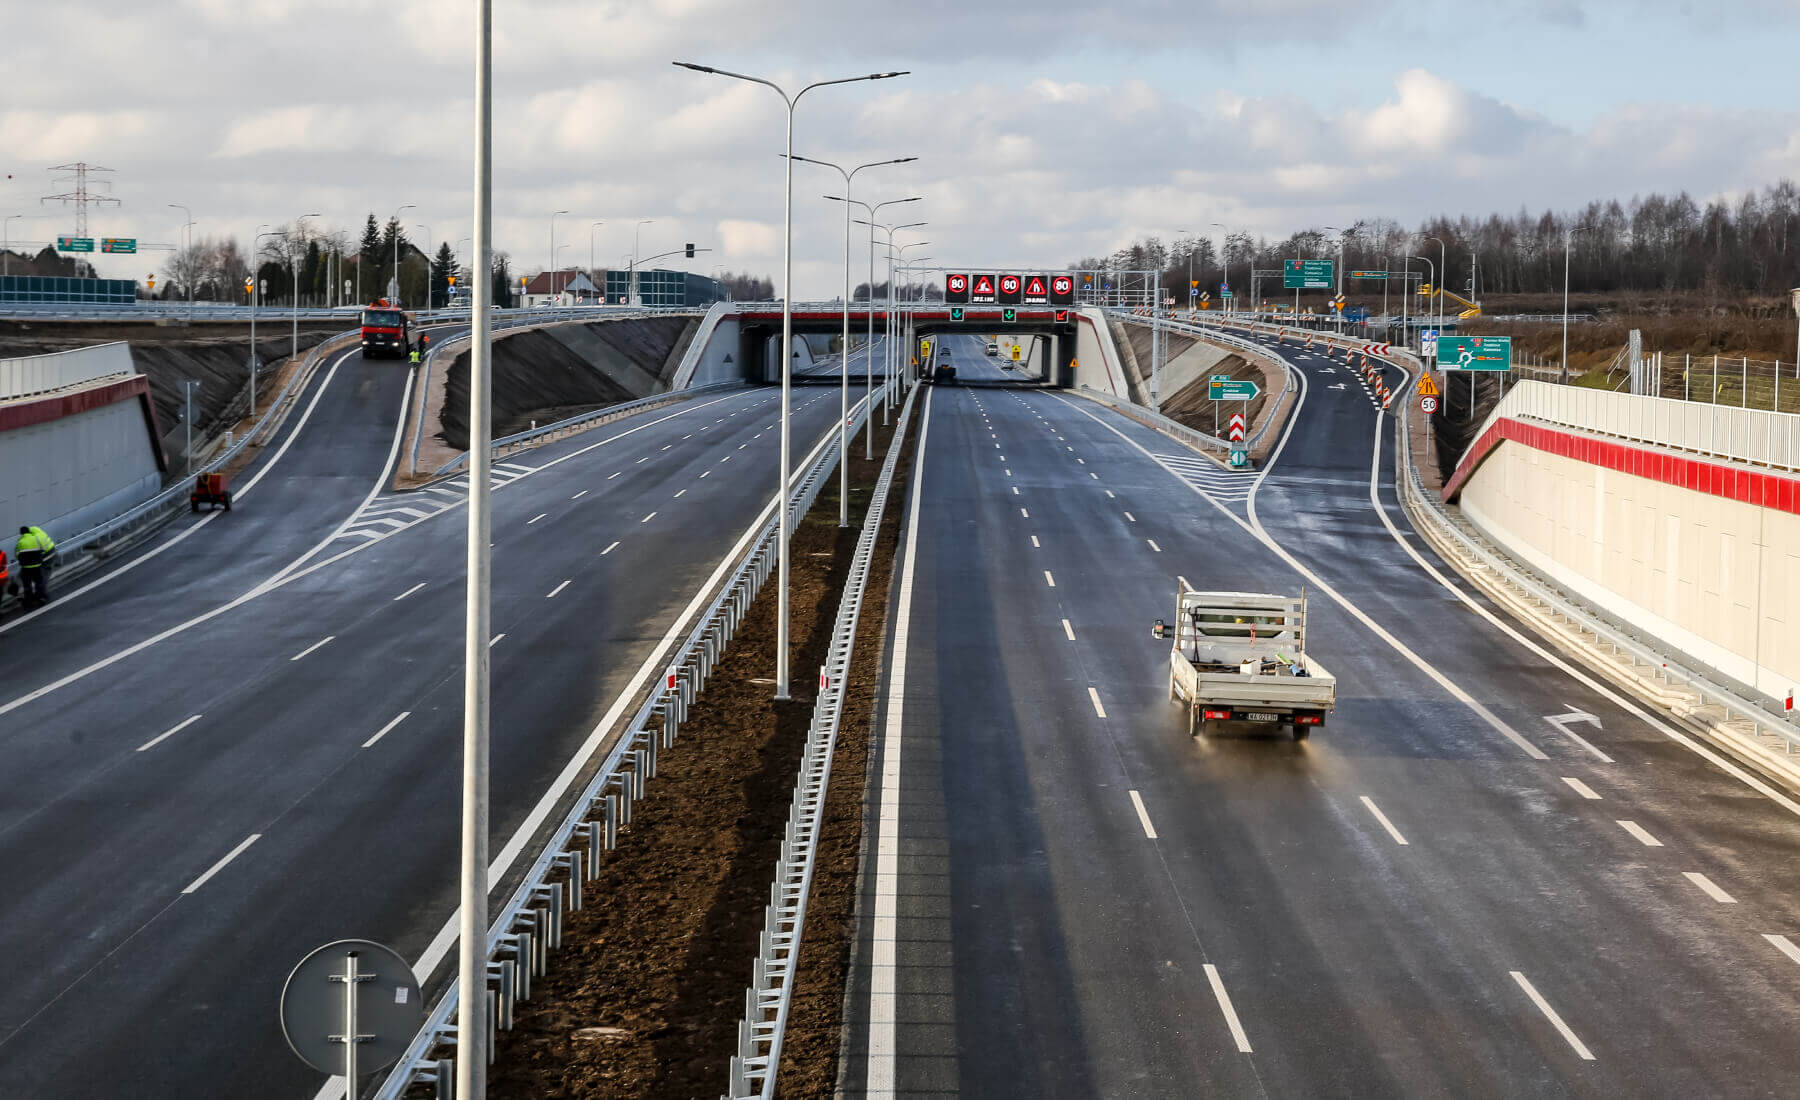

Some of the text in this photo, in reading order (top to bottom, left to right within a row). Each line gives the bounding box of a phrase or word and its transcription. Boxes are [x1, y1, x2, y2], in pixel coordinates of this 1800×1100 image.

[951, 279, 964, 288] 80
[1003, 280, 1016, 289] 80
[1056, 281, 1068, 290] 80
[1423, 400, 1436, 409] 50
